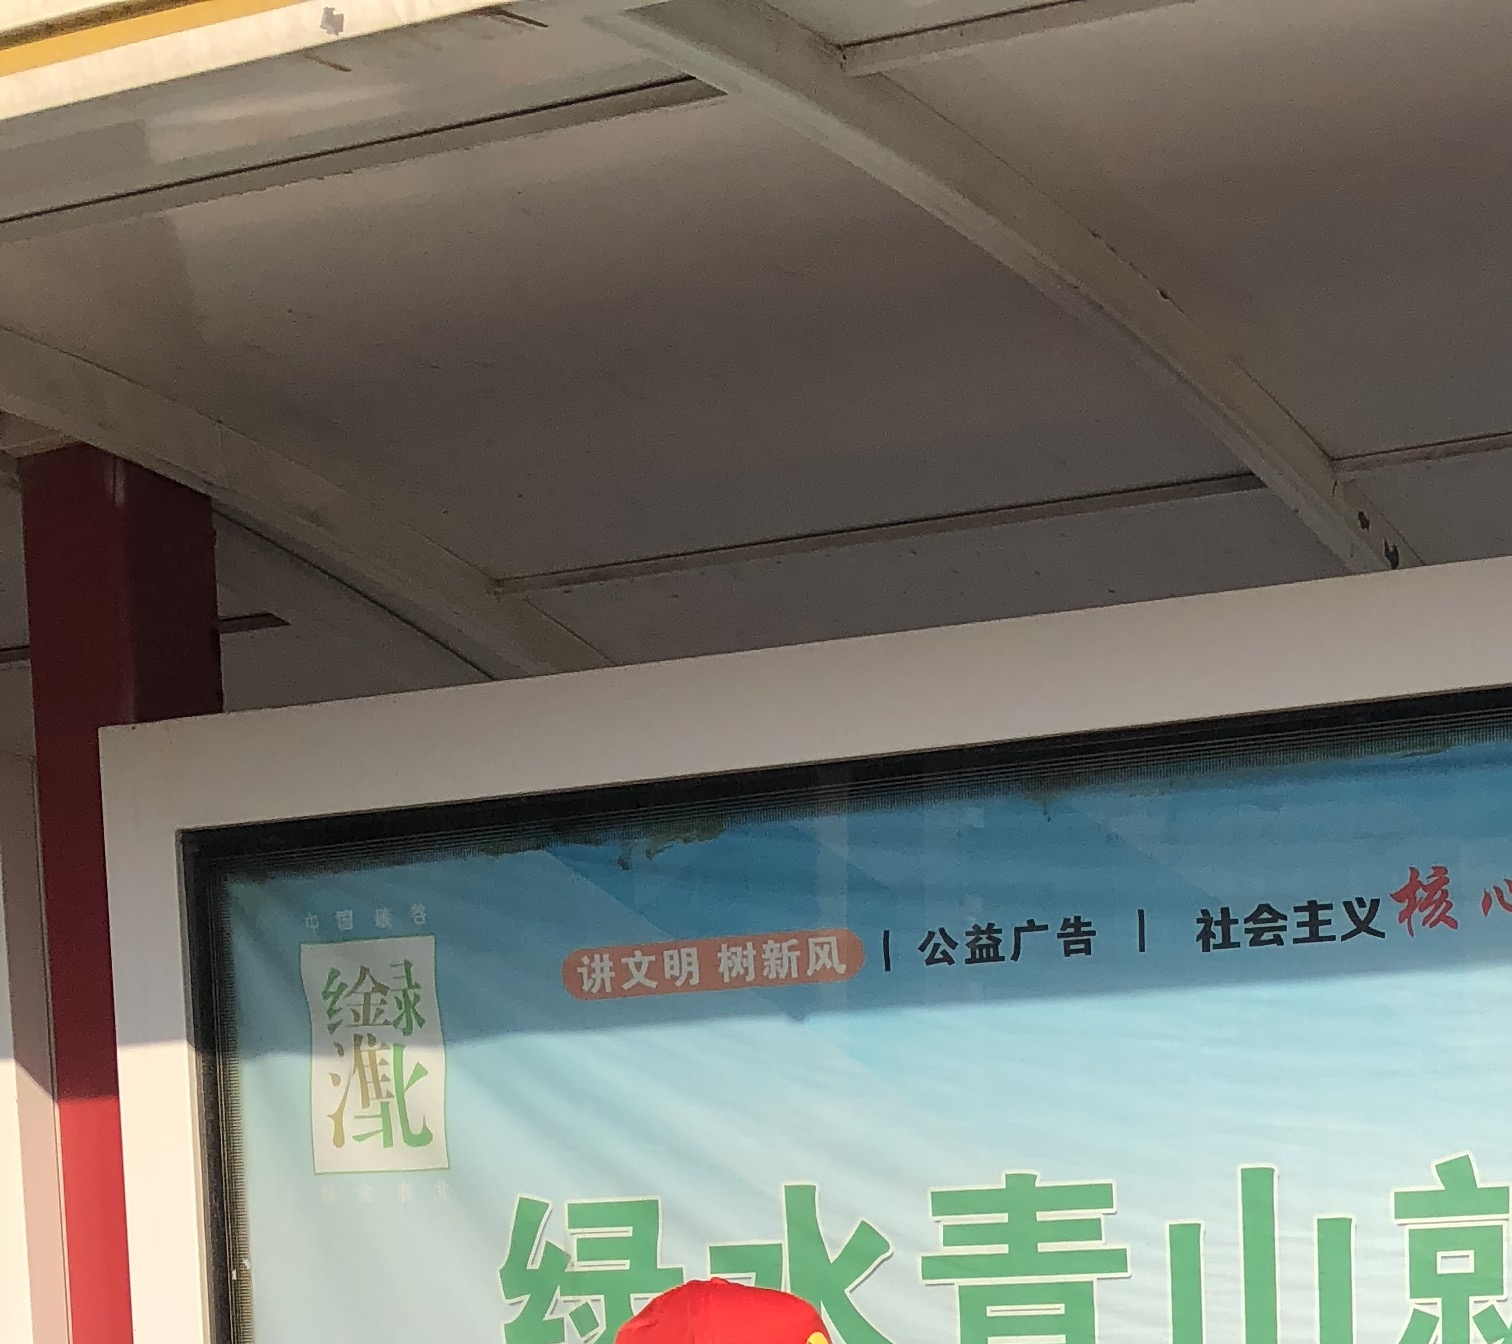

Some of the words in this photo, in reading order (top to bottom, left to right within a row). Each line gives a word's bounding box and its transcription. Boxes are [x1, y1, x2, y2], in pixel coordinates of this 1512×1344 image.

[576, 947, 701, 995] 讲文明
[717, 935, 847, 982] 树新风
[917, 914, 1098, 967] 公益广告
